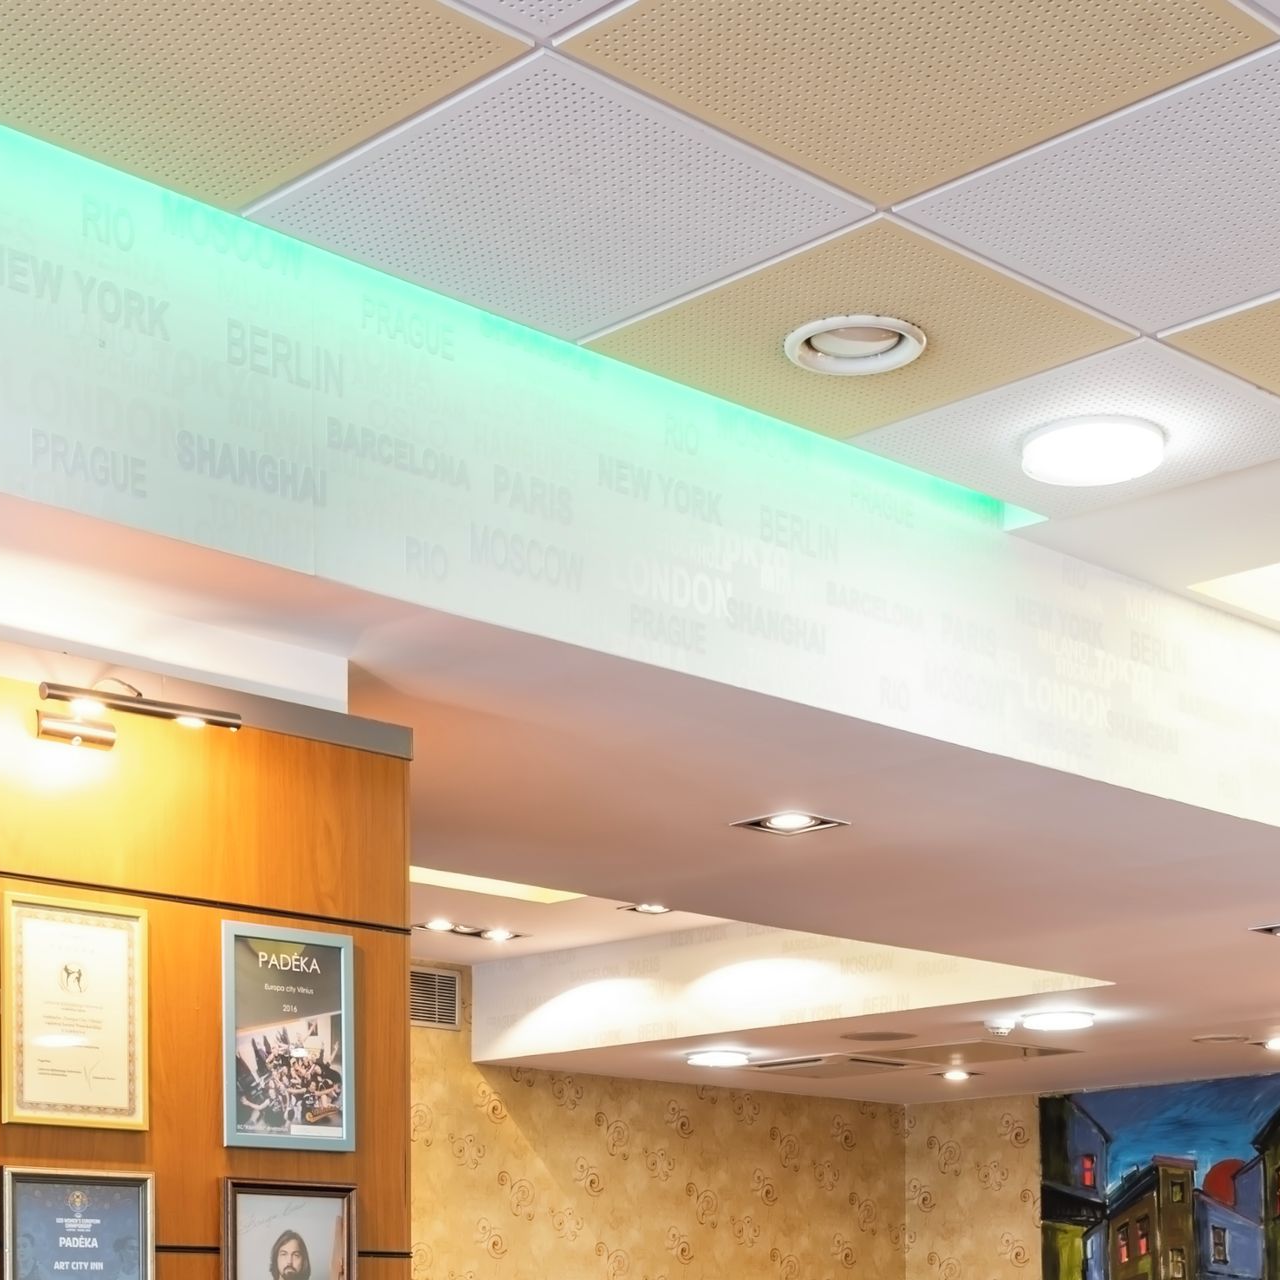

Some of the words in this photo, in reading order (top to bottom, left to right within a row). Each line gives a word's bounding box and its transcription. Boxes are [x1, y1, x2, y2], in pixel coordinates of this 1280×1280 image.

[81, 192, 137, 253] RIO
[71, 268, 172, 342] YORK
[360, 292, 456, 363] PRAGUE
[226, 316, 346, 399] BERLIN
[30, 426, 150, 500] PRAGUE
[175, 428, 328, 509] SHANGHAI
[326, 414, 472, 492] BARCELONA
[492, 462, 576, 526] PARIS
[597, 452, 654, 504] NEW
[656, 472, 725, 528] YORK
[404, 533, 450, 582] RIO
[469, 519, 586, 592] MOSCOW
[759, 503, 840, 564] BERLIN
[258, 952, 321, 974] PADĖKA
[264, 983, 285, 993] Europa
[285, 985, 296, 995] city
[296, 986, 314, 995] Vilnius
[282, 1004, 298, 1014] 2016
[53, 1261, 70, 1271] ART
[71, 1261, 90, 1271] CITY
[90, 1261, 104, 1271] INN
[58, 1235, 99, 1249] PADĖKA
